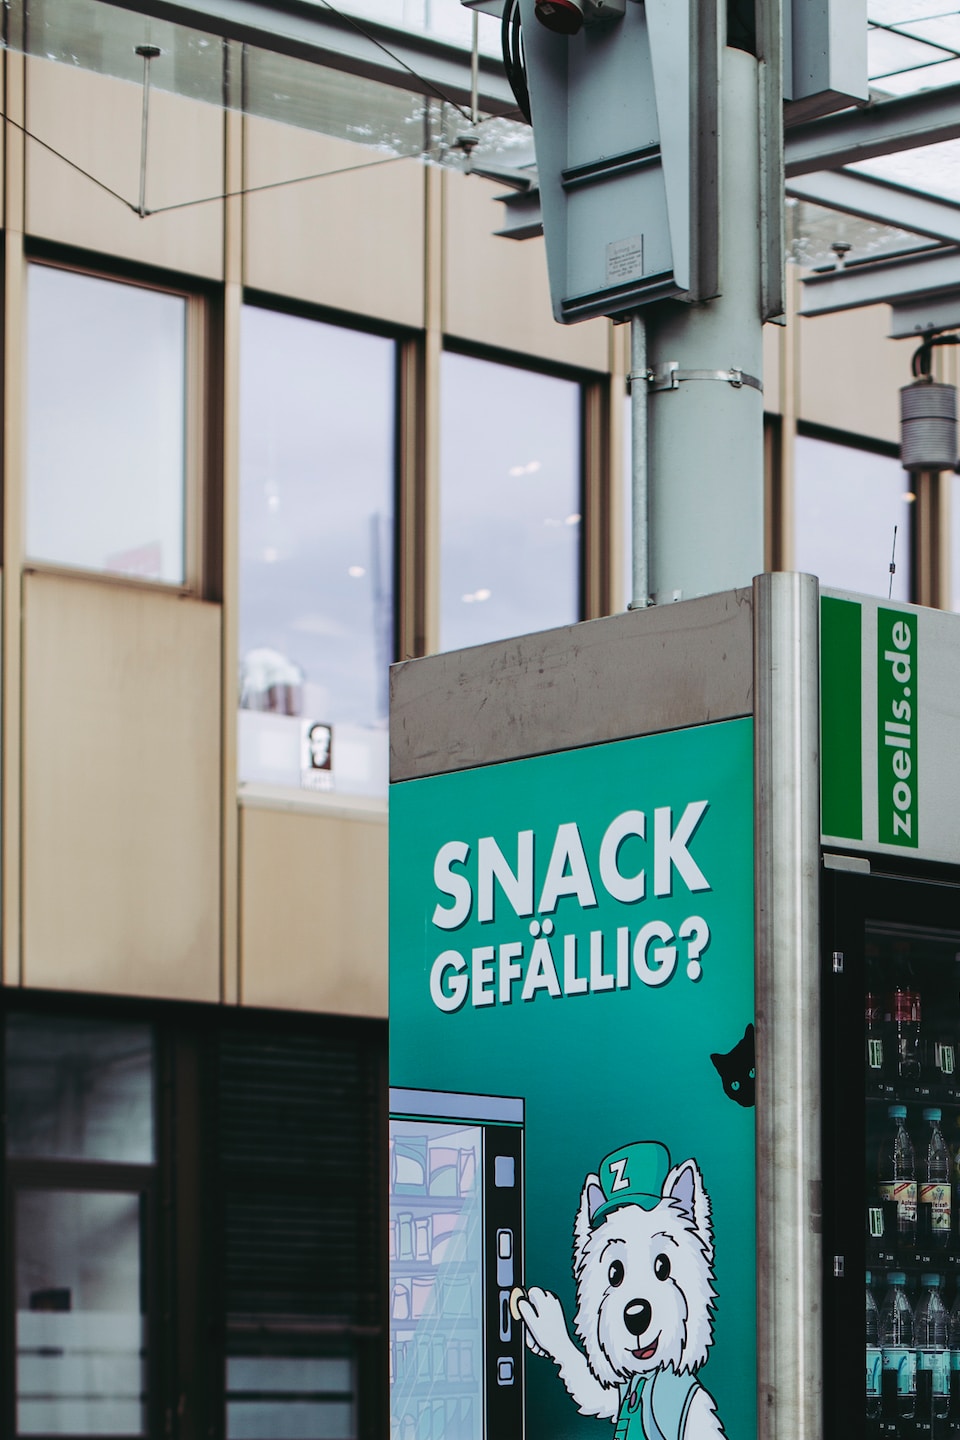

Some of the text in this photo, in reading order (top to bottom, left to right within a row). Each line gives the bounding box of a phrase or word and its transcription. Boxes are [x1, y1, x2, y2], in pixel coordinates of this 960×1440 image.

[885, 620, 911, 839] zoells.de
[432, 800, 712, 930] SNACK
[429, 915, 711, 1013] GEFÄLLIG?
[608, 1157, 630, 1193] Z
